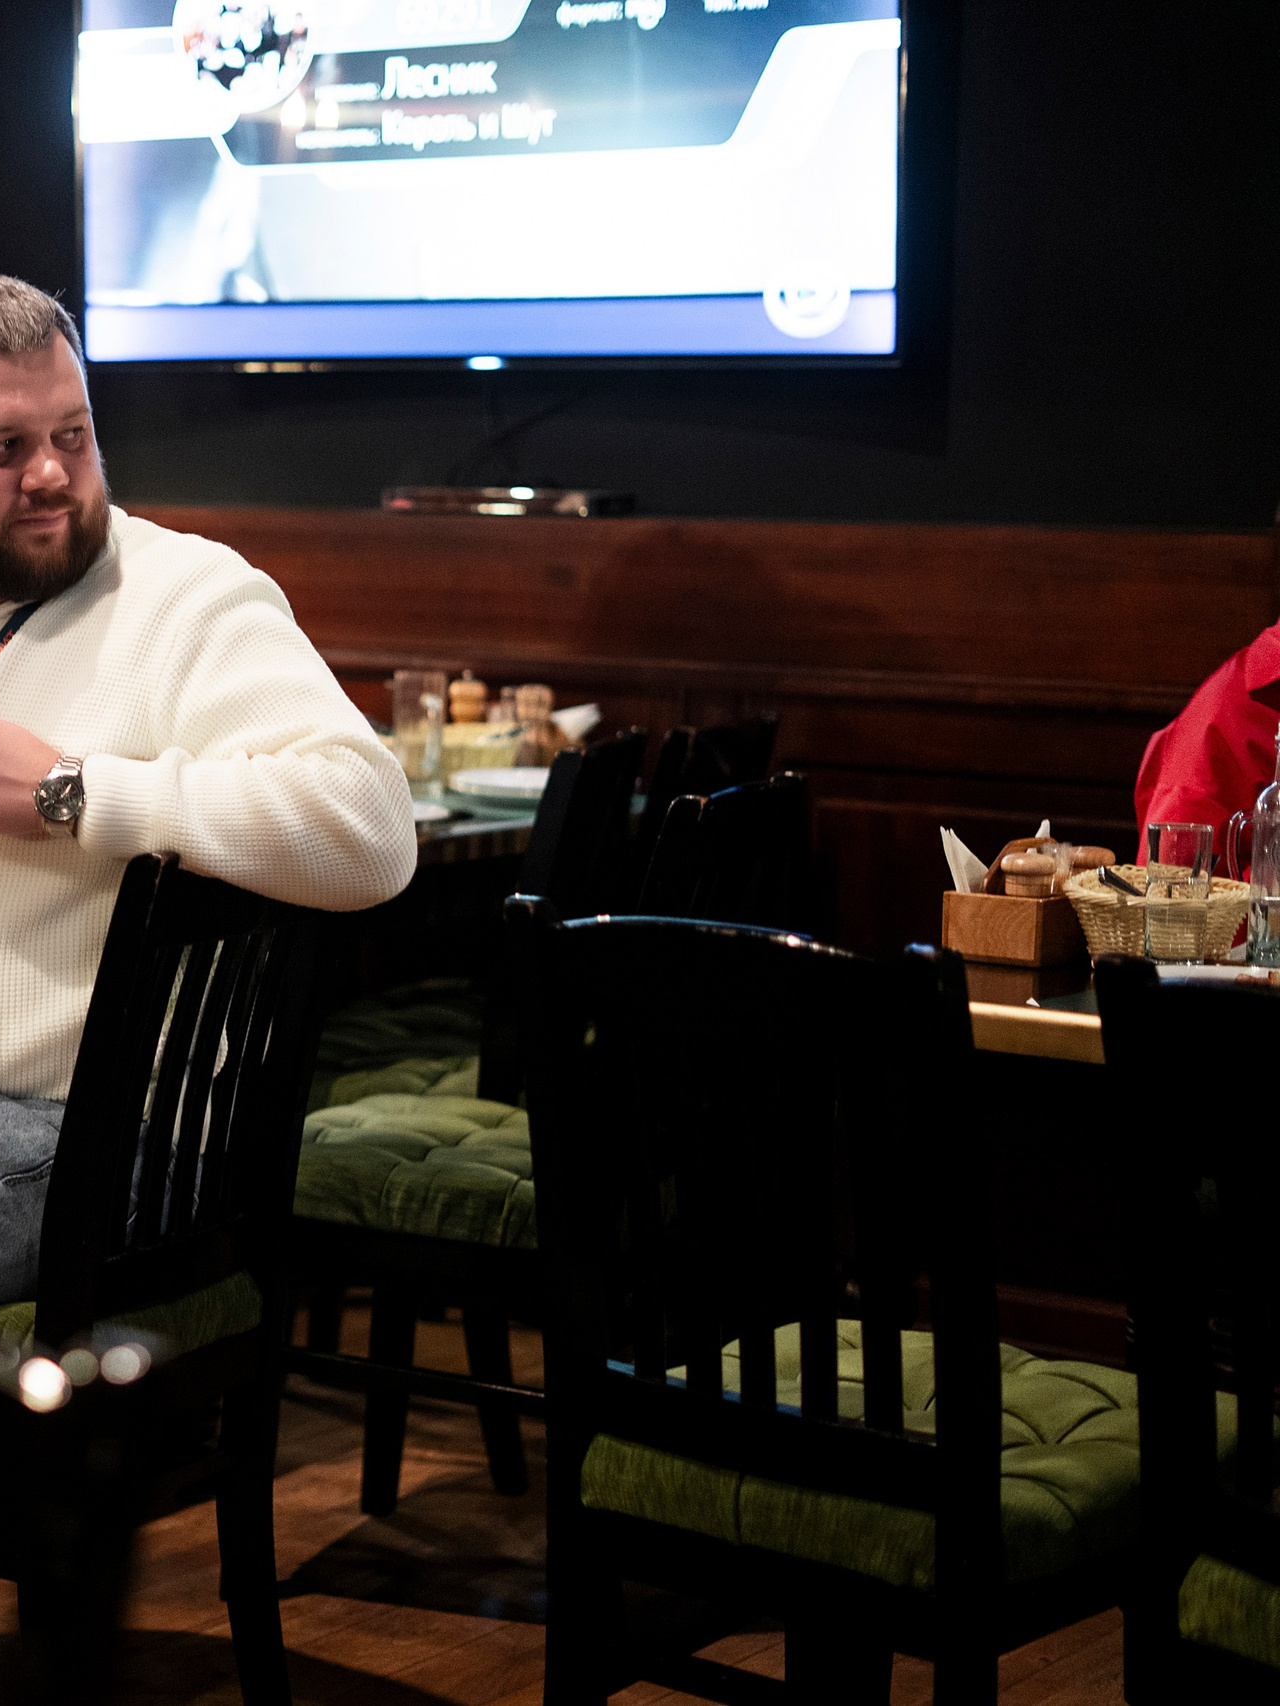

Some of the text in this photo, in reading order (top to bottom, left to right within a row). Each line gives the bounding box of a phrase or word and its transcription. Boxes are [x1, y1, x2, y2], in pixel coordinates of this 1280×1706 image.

[381, 56, 498, 100] Лесник
[382, 109, 477, 151] Король
[478, 112, 499, 140] и
[501, 103, 557, 145] Шут
